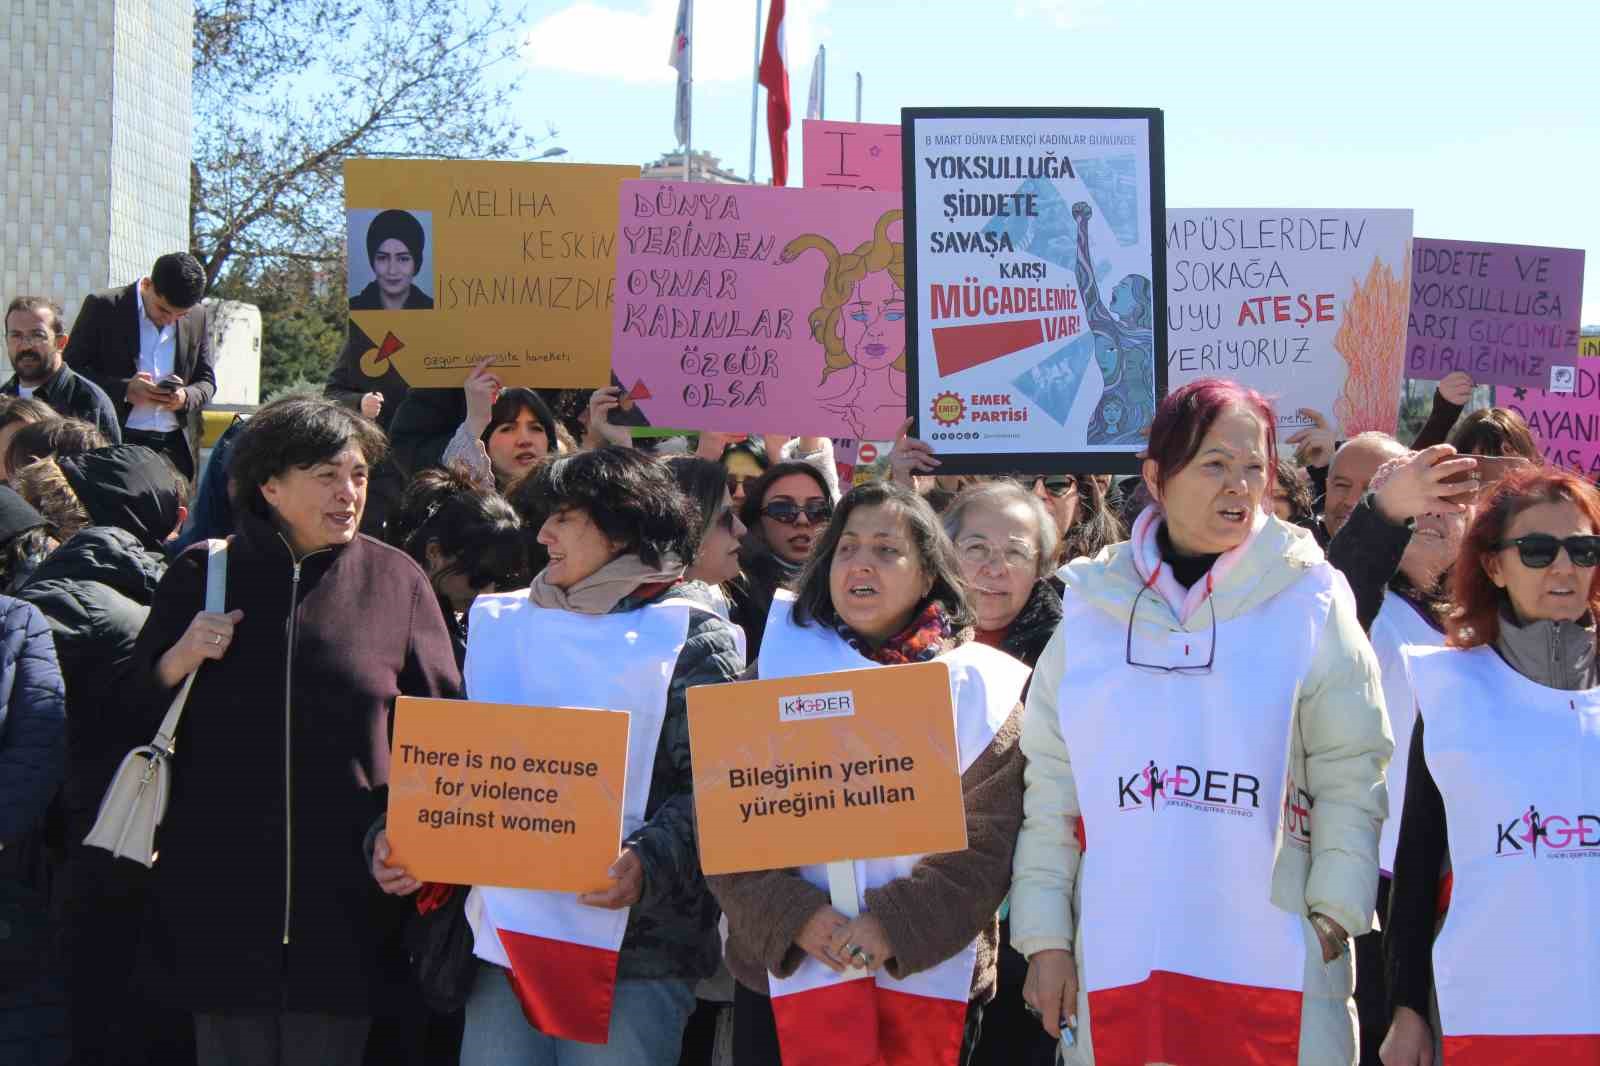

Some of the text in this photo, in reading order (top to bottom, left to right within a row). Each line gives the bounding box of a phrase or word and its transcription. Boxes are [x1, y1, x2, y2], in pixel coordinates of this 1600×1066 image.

[934, 135, 962, 146] MART
[965, 133, 998, 146] DÜNYA
[1000, 133, 1037, 148] EMEKÇİ
[1039, 134, 1087, 146] KADINLAR
[925, 151, 1076, 180] YOKSULLUĞA
[448, 188, 556, 217] MELİHA
[634, 185, 740, 220] DÜNYA
[943, 188, 1039, 223] ŞİDDETE
[623, 220, 777, 262] YERİNDEN
[930, 231, 1015, 258] SAVAŞA
[627, 268, 738, 300] OYNAR
[999, 262, 1047, 283] KARŞI
[1172, 259, 1289, 292] SOKAĞA
[1515, 256, 1551, 283] VE
[930, 277, 1078, 320] MÜCADELEMİZ
[1237, 294, 1335, 329] ATEŞE
[1412, 283, 1563, 319] YOKSULLUĞA
[622, 303, 794, 340] KADINLAR
[1043, 315, 1081, 343] VAR!
[680, 345, 779, 378] ÖZGÜR
[683, 380, 768, 408] OLSA
[971, 394, 1012, 406] EMEK
[971, 406, 1029, 422] PARTİSİ
[400, 744, 599, 777] There is no excuse
[728, 754, 915, 789] Bileğinin yerine
[435, 776, 559, 804] for violence
[739, 785, 916, 824] yüreğini kullan
[418, 807, 577, 835] against women
